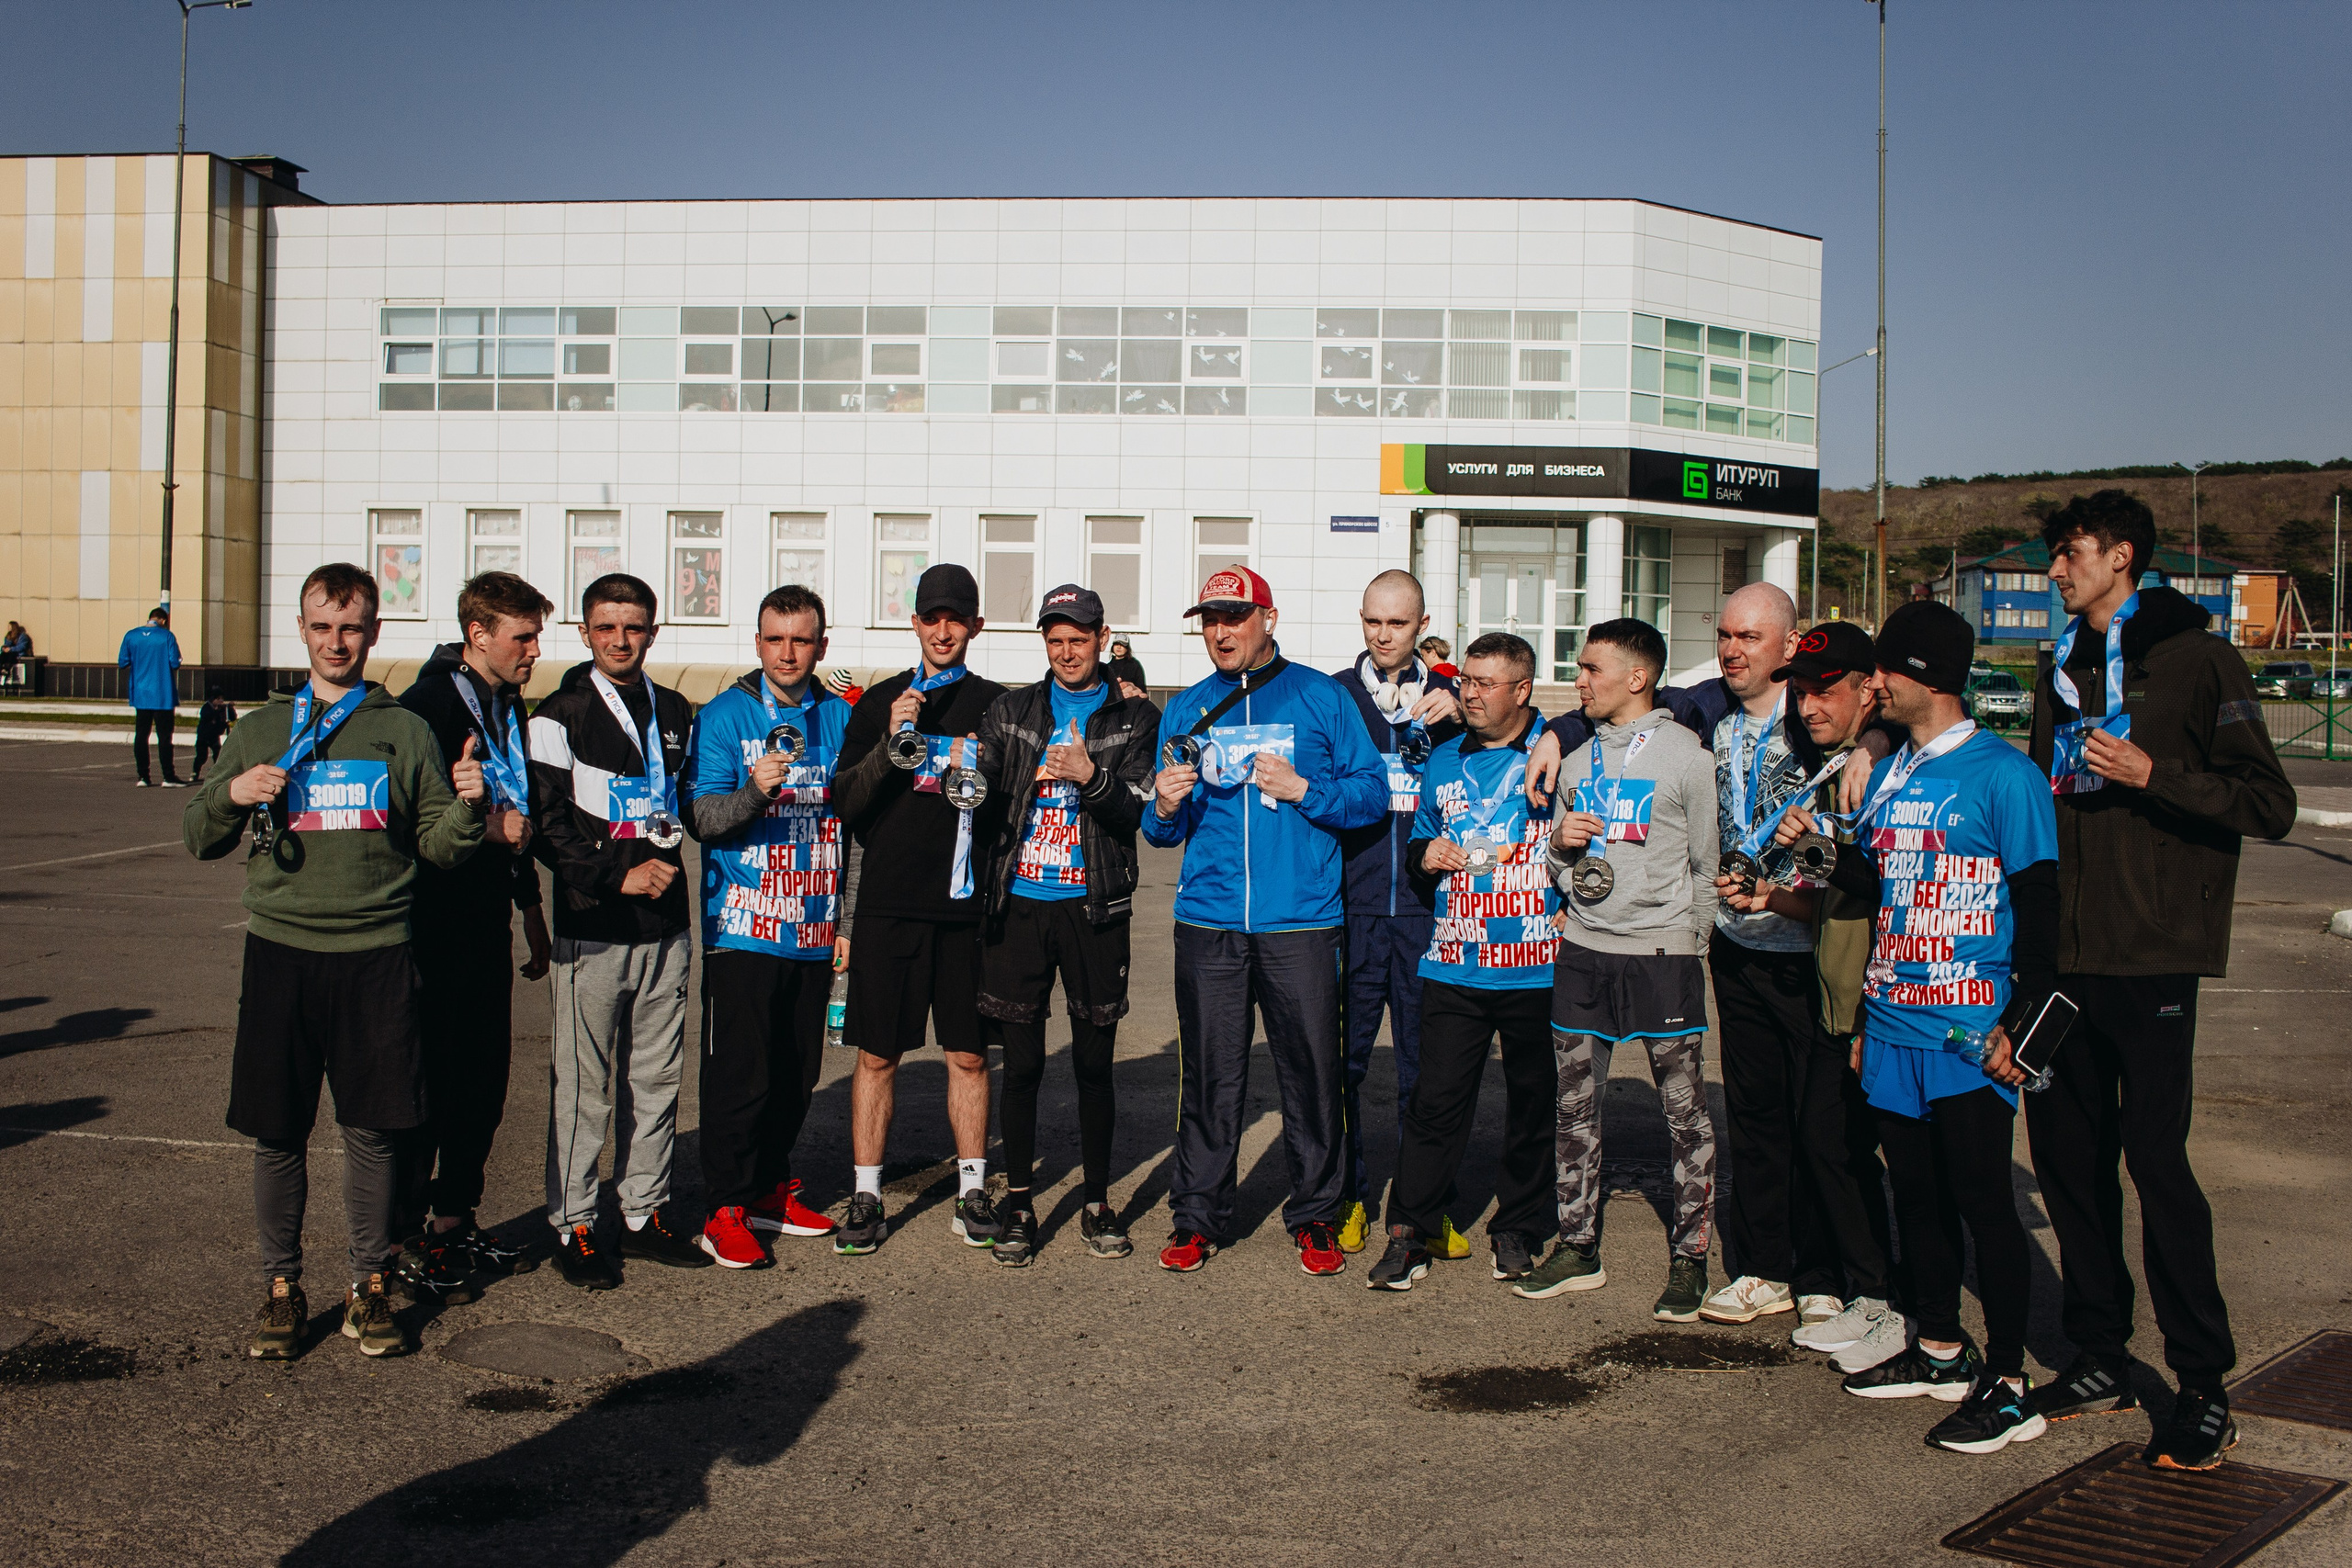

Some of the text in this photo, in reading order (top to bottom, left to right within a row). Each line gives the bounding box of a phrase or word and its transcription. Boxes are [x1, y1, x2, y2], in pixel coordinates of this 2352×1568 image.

[1447, 463, 1605, 477] УСЛУГИ ДЛЯ БИЗНЕСА
[1716, 463, 1780, 489] ИТУРУП
[1715, 487, 1743, 502] БАНК
[678, 568, 696, 595] 9
[2110, 625, 2119, 645] ПСБ
[2056, 644, 2067, 661] ПСБ
[297, 707, 305, 724] ПСБ
[330, 707, 345, 721] ПСБ
[611, 698, 623, 715] ПСБ
[769, 708, 778, 721] ПСБ
[1529, 733, 1540, 748] ПСБ
[1630, 740, 1642, 756] ПСБ
[1912, 751, 1929, 765] ПСБ
[786, 765, 827, 785] 30021
[1387, 773, 1422, 793] 0022
[309, 783, 368, 807] 30019
[626, 797, 651, 818] 300
[1890, 801, 1934, 826] 30012
[633, 821, 647, 838] 10
[741, 843, 797, 870] #ЗАБЕГ
[1934, 852, 2001, 884] #ЦЕЛЬ
[725, 883, 806, 923] #ЛЮБОВЬ
[1447, 889, 1545, 919] #ГОРДОСТЬ
[1892, 880, 1999, 910] #ЗАБЕГ2024
[717, 908, 782, 943] #ЗАБЕГ
[1905, 907, 1996, 936] #МОМЕНТ
[1927, 960, 1978, 987] 2024
[1888, 977, 1996, 1006] #ЕДИНСТВО
